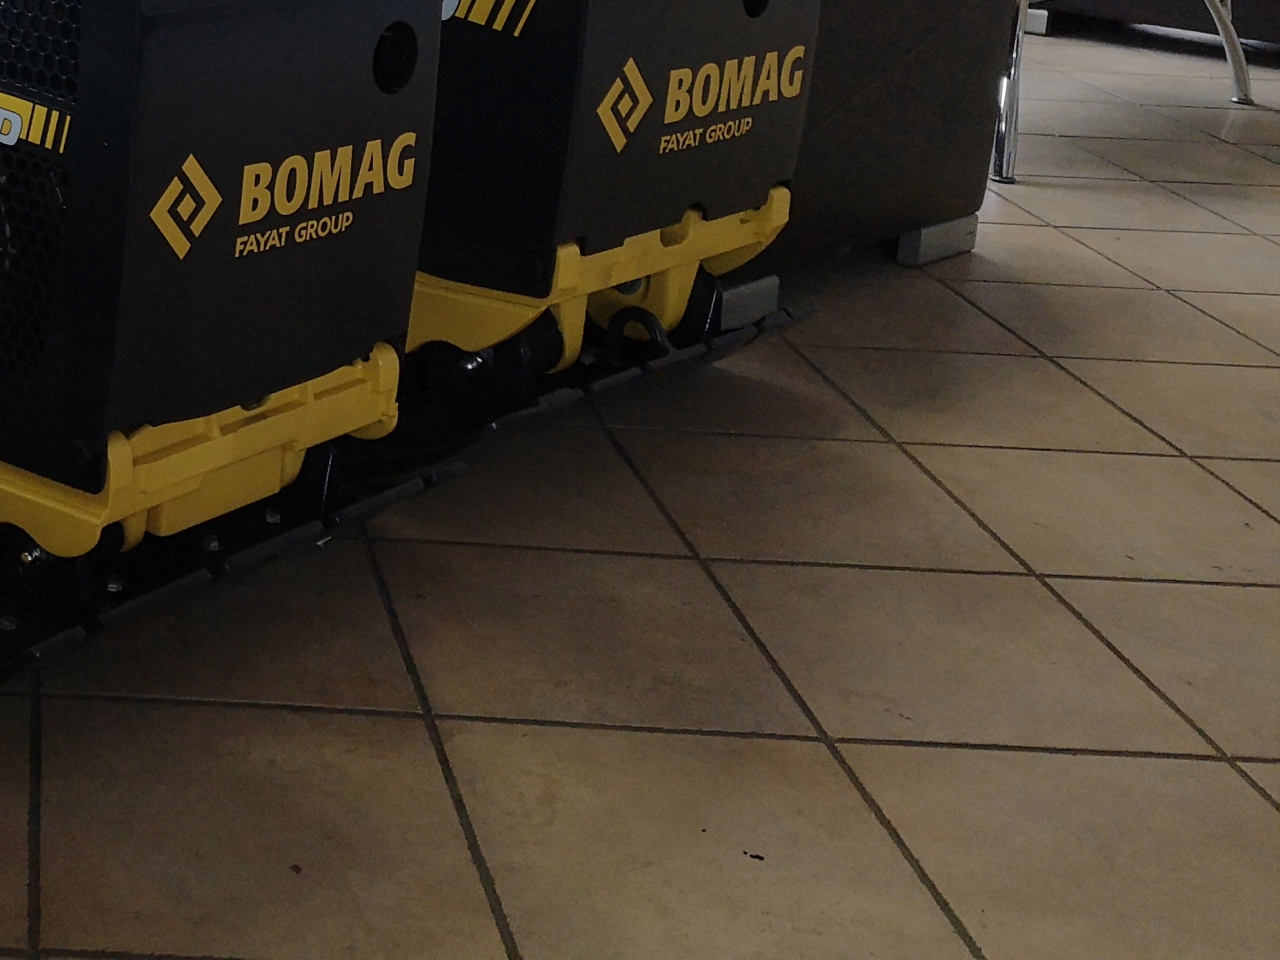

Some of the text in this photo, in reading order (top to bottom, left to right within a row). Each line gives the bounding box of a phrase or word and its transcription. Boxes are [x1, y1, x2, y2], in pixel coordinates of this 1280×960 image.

[663, 45, 806, 125] BOMAG
[658, 117, 753, 155] FAYAT GROUP
[238, 131, 417, 226] BOMAG
[234, 211, 354, 258] FAYAT GROUP
